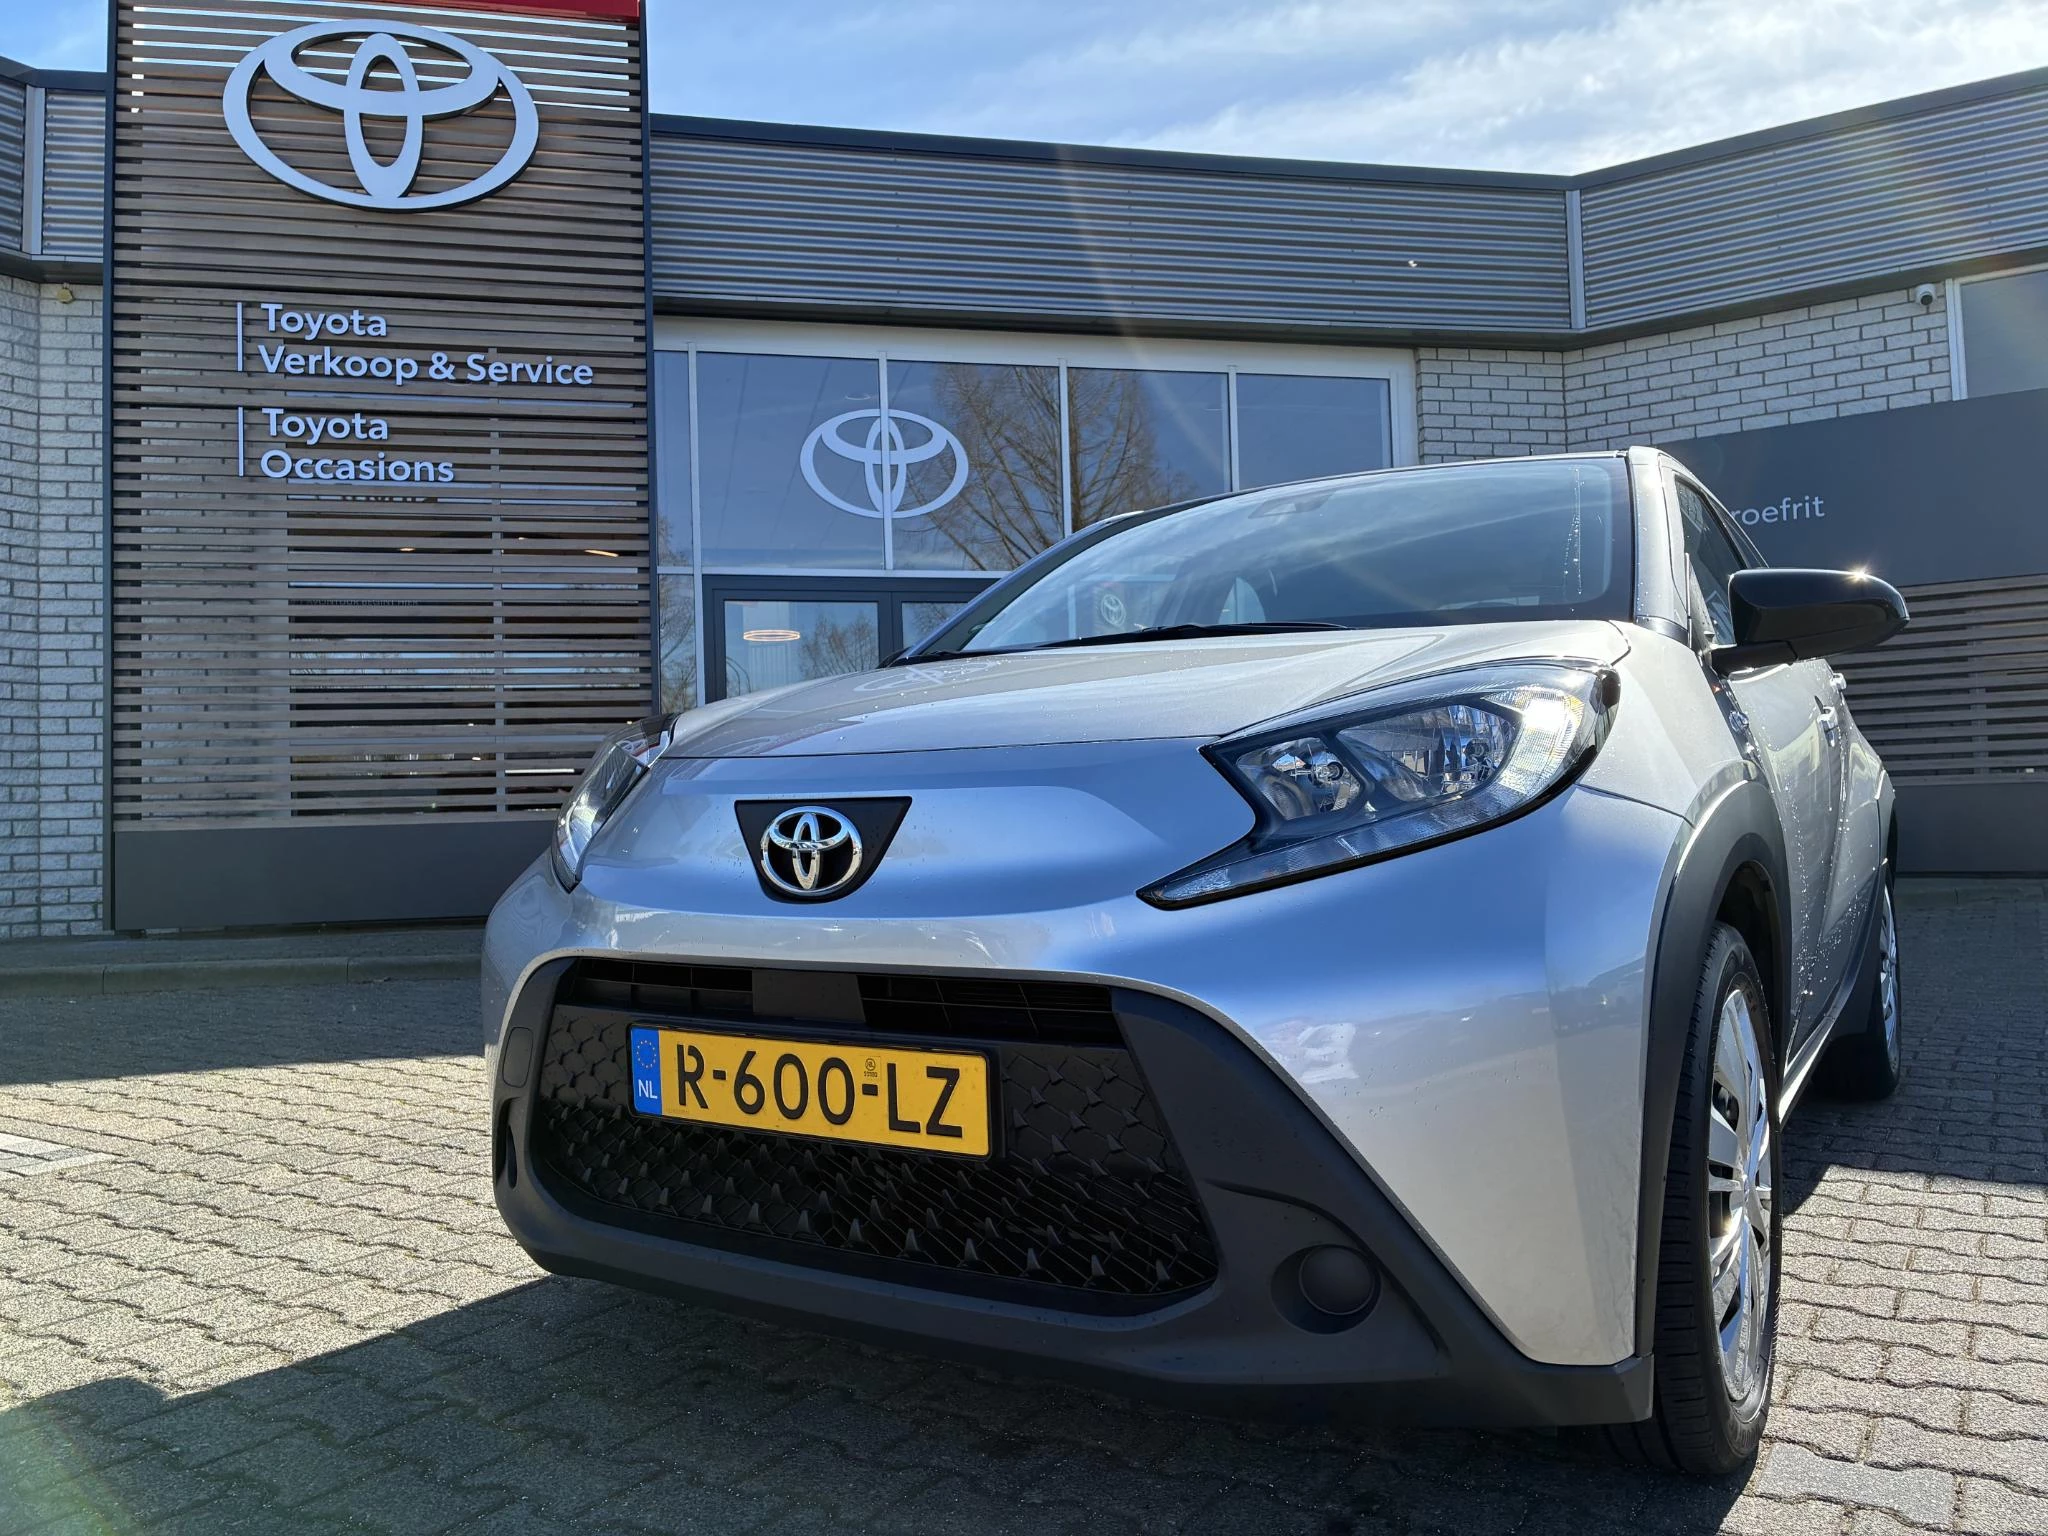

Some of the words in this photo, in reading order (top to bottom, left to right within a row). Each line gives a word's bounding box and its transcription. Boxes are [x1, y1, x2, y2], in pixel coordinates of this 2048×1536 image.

[260, 303, 388, 340] Toyota
[258, 344, 419, 385] Verkoop
[428, 351, 457, 381] &
[466, 353, 594, 386] Service
[261, 408, 389, 445] Toyota
[260, 449, 455, 483] Occasions
[1731, 495, 1825, 526] roefrit
[637, 1079, 658, 1100] NL
[676, 1043, 964, 1138] R-600-LZ
